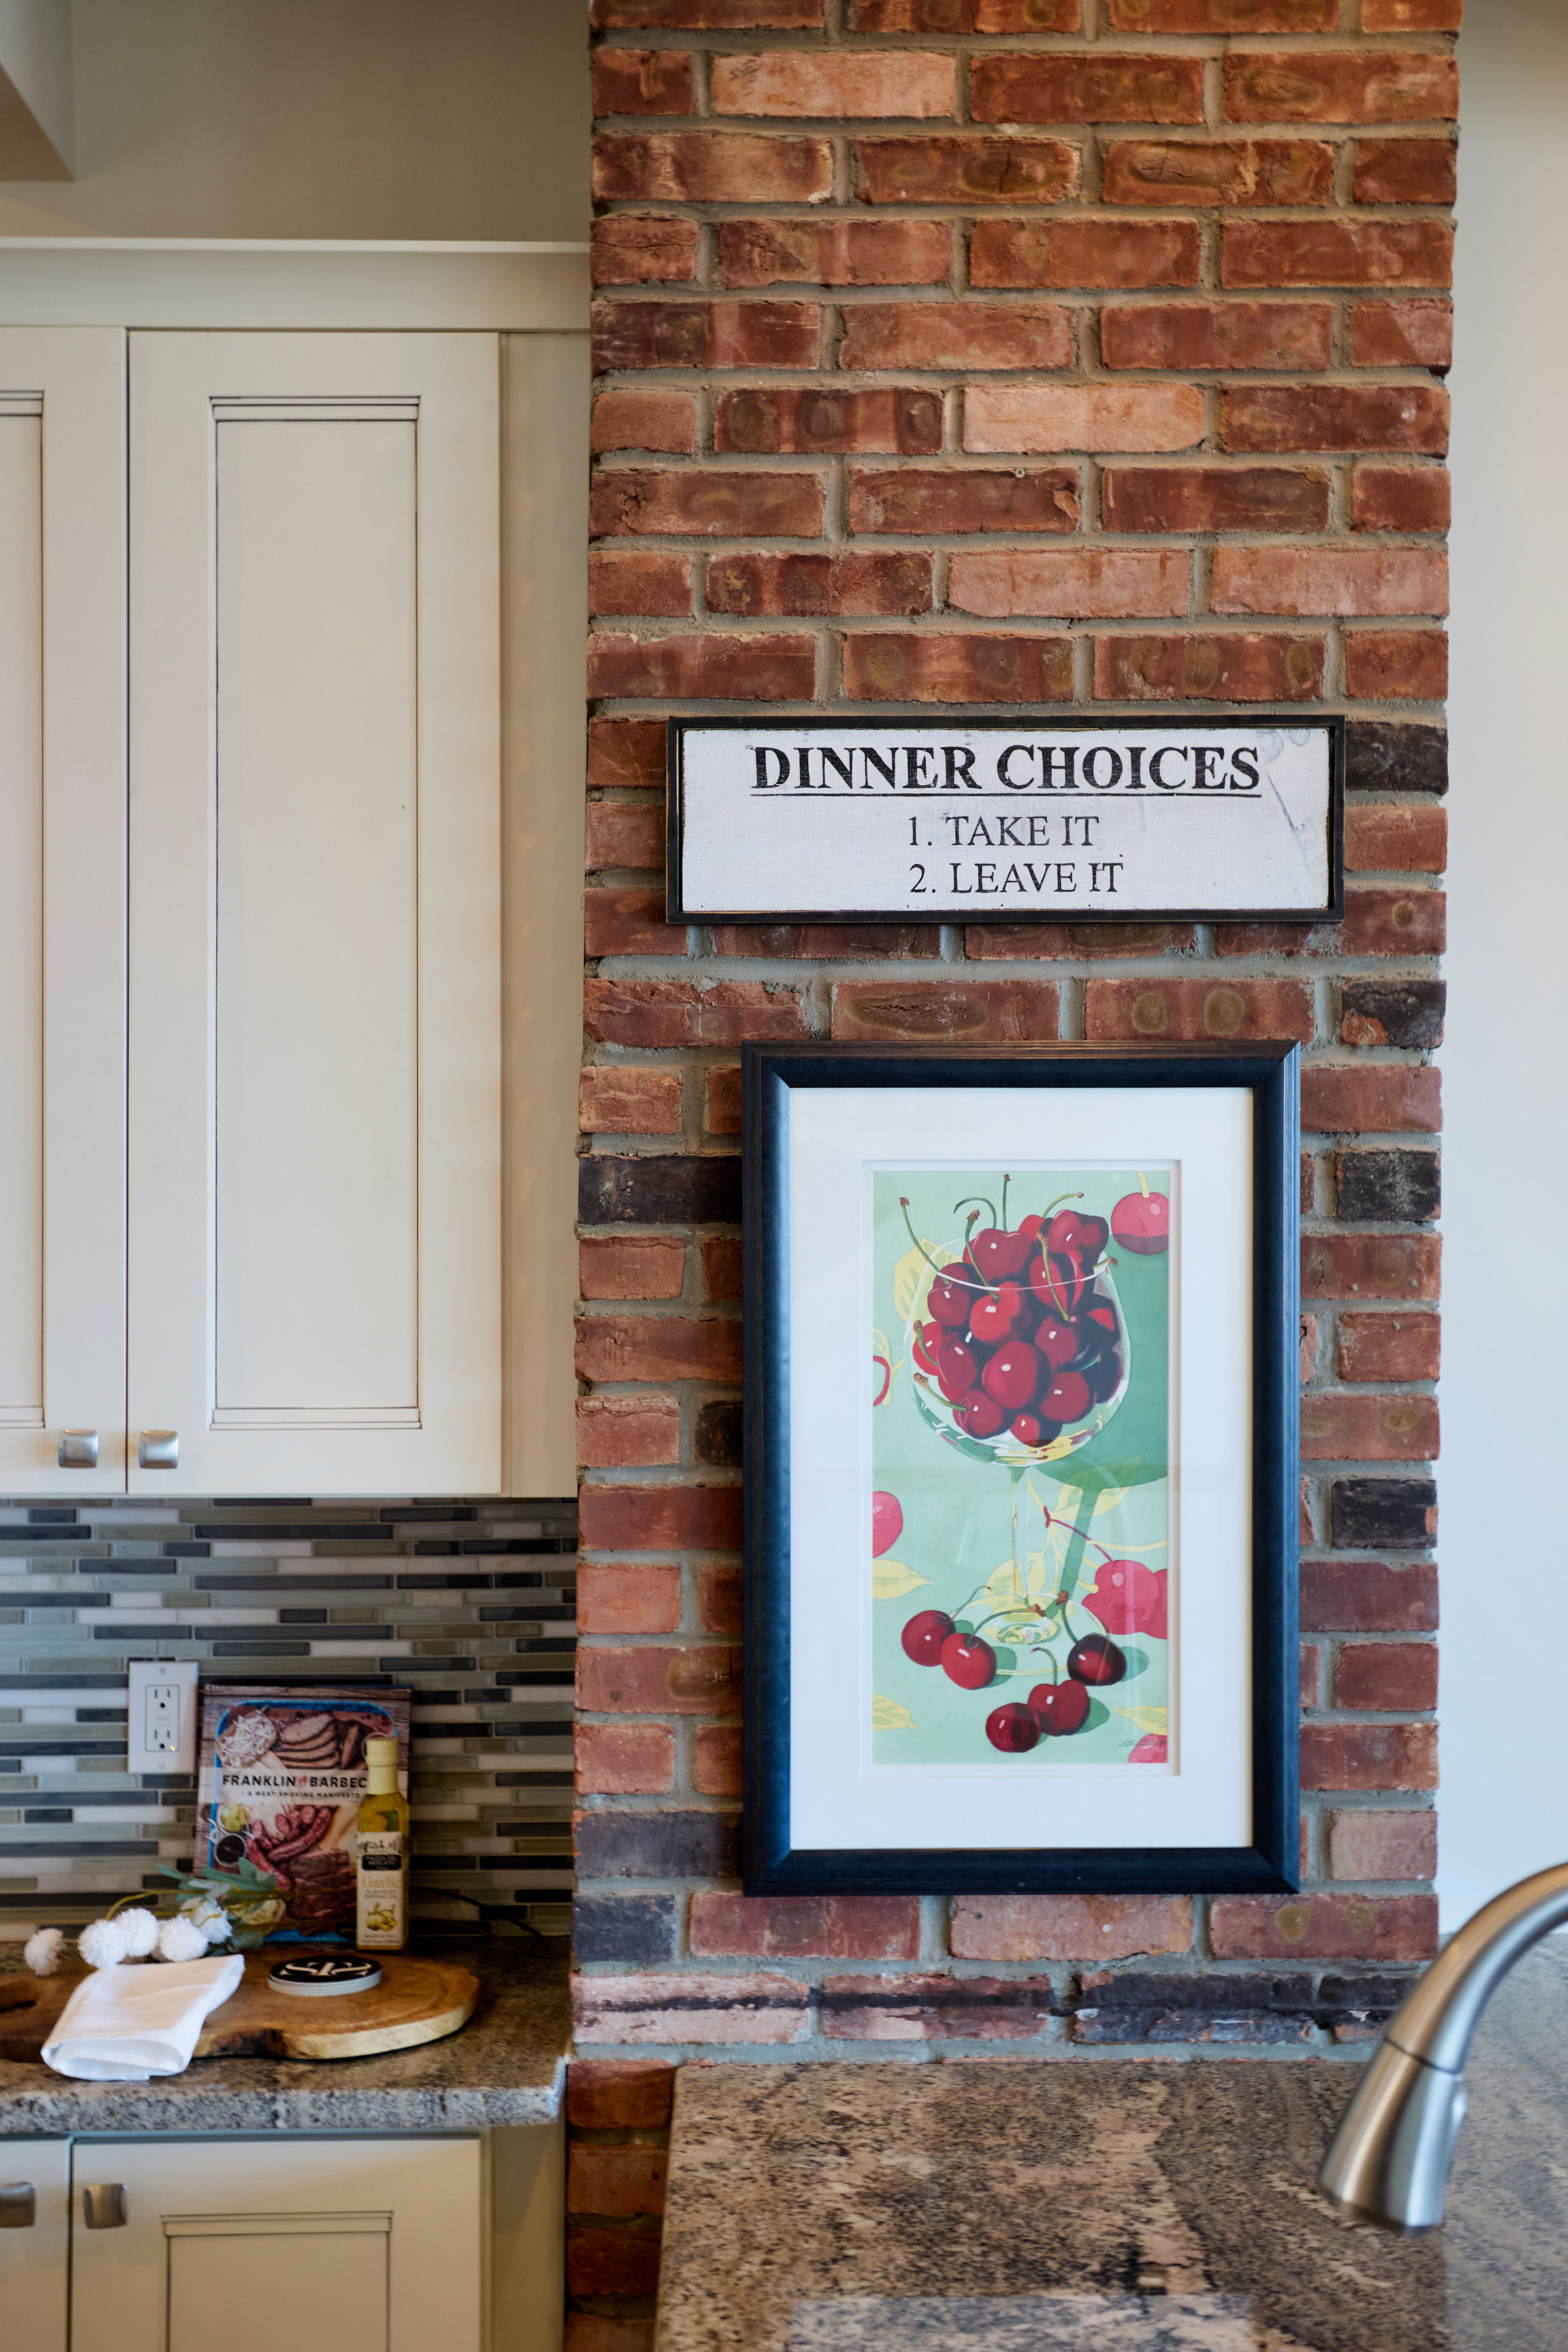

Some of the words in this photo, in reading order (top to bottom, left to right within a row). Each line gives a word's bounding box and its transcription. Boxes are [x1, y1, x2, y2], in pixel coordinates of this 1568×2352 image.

[751, 746, 983, 790] DINNER
[996, 744, 1260, 791] CHOICES
[908, 816, 933, 846] 1.
[945, 815, 1050, 847] TAKE
[1061, 816, 1100, 847] IT
[909, 863, 936, 893] 2.
[949, 862, 1077, 894] LEAVE
[1088, 862, 1124, 893] IT
[222, 1774, 297, 1788] FRANKLIN
[310, 1776, 368, 1789] BARBEC
[362, 1876, 402, 1889] Garlic
